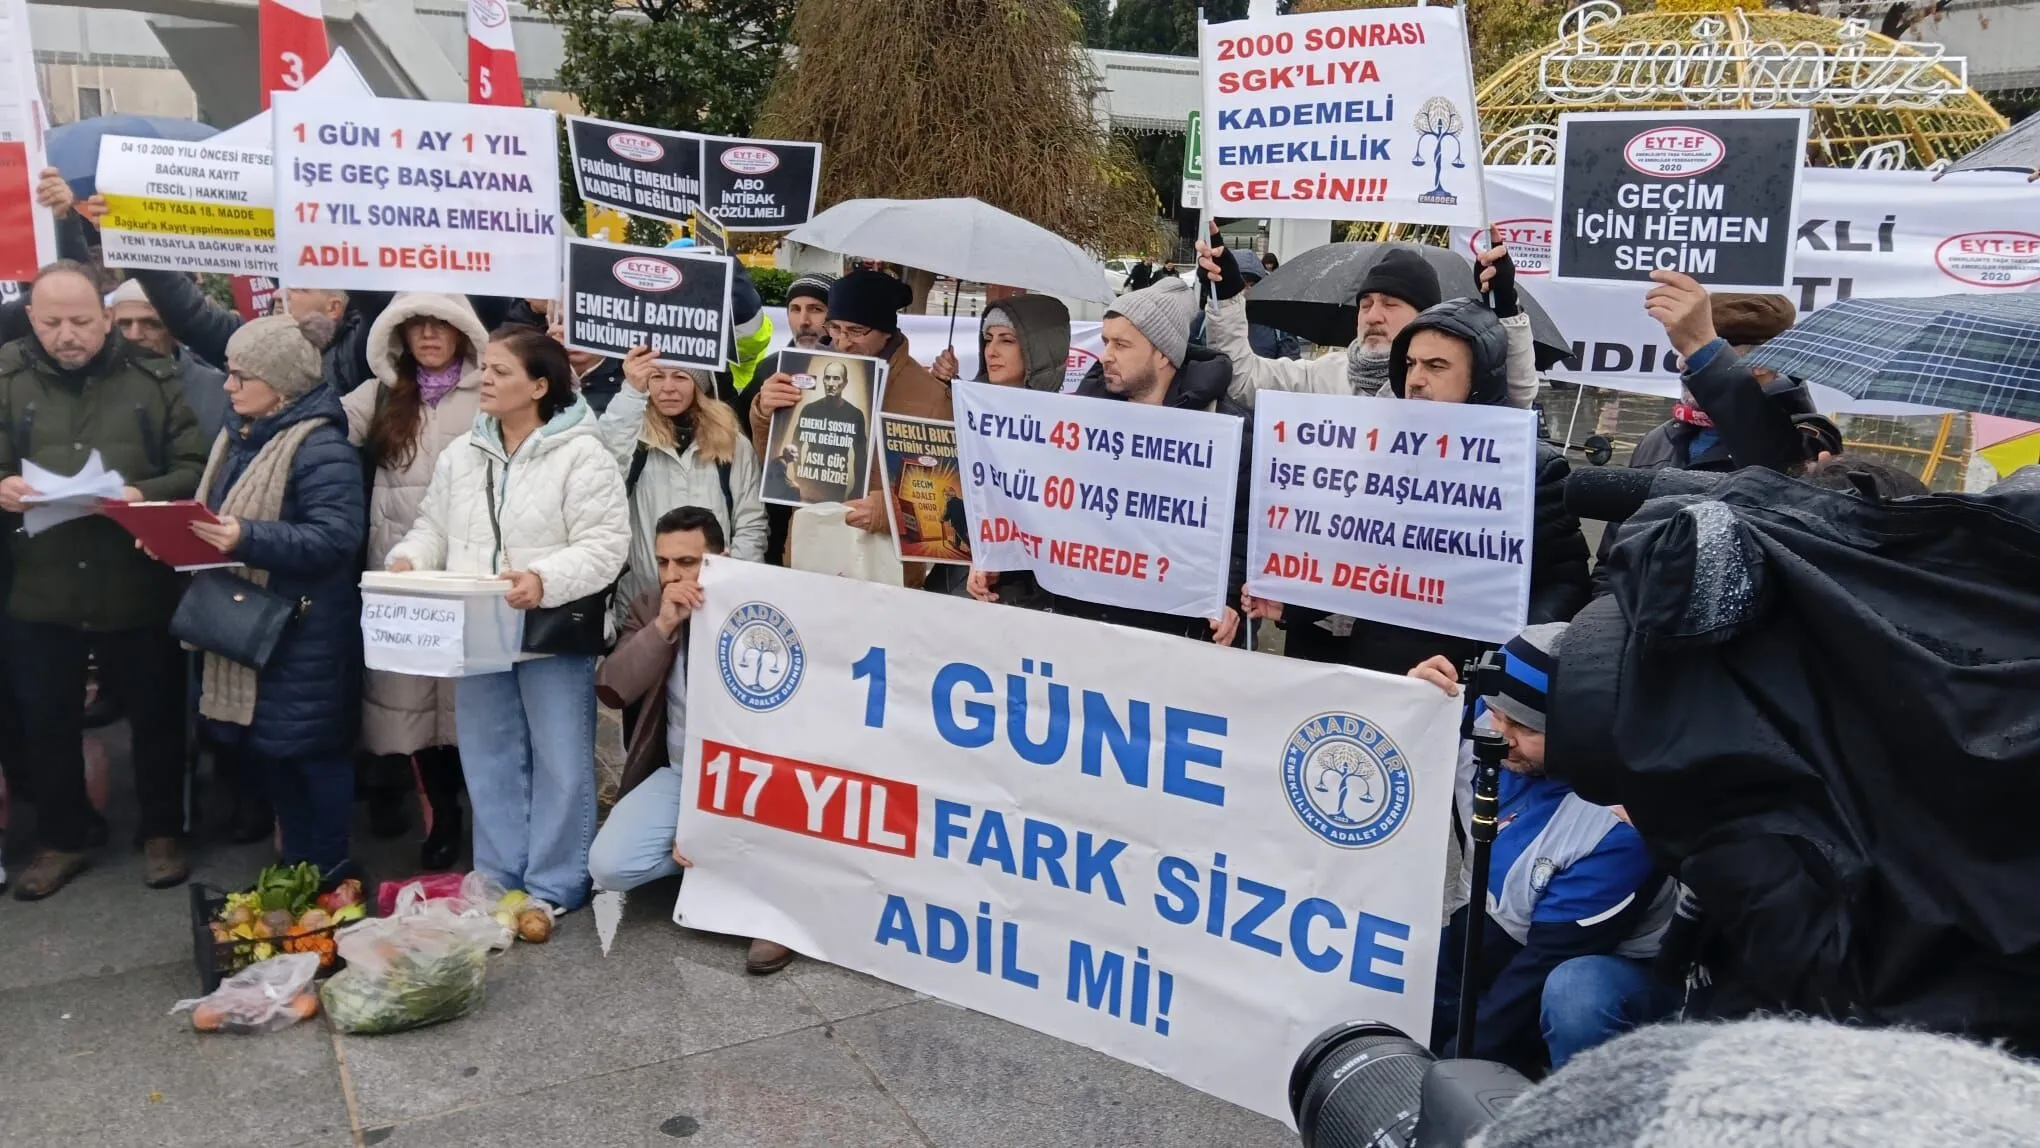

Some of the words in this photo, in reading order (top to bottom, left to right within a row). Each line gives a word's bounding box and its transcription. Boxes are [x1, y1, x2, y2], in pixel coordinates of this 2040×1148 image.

[1217, 32, 1294, 61] 2000
[1304, 22, 1426, 52] SONRASI
[280, 51, 304, 89] 3
[479, 67, 492, 99] 5
[1218, 60, 1381, 94] SGK'LIYA
[1218, 94, 1394, 131] KADEMELİ
[121, 142, 133, 152] 04
[137, 143, 148, 154] 10
[151, 144, 175, 156] 2000
[200, 148, 238, 163] ÖNCESİ
[293, 122, 305, 143] 1
[318, 121, 380, 148] GÜN
[391, 129, 403, 149] 1
[416, 131, 452, 151] AY
[462, 133, 474, 153] 1
[484, 134, 527, 156] YIL
[1219, 134, 1392, 166] EMEKLİLİK
[1645, 136, 1705, 148] EYT-EF
[155, 162, 206, 178] BAĞKURA
[209, 169, 240, 181] KAYIT
[293, 157, 333, 188] İŞE
[341, 164, 390, 189] GEÇ
[399, 167, 533, 193] BAŞLAYANA
[580, 157, 632, 182] FAKİRLİK
[634, 168, 699, 195] EMEKLİNİN
[733, 179, 765, 190] ABO
[1220, 172, 1388, 202] GELSİN!!!
[196, 188, 248, 202] HAKKIMIZ
[584, 176, 632, 202] KADERİ
[721, 190, 775, 205] İNTİBAK
[1617, 179, 1724, 215] GEÇİM
[142, 201, 167, 213] 1479
[170, 203, 196, 217] YASA
[218, 208, 254, 221] MADDE
[294, 203, 319, 224] 17
[326, 203, 361, 225] YIL
[368, 205, 441, 229] SONRA
[447, 207, 555, 236] EMEKLİLİK
[1576, 208, 1635, 244] İÇİN
[1644, 215, 1768, 243] HEMEN
[150, 236, 195, 250] YASAYLA
[298, 241, 369, 268] ADİL
[378, 244, 491, 273] DEĞİL!!!
[1960, 239, 2040, 254] EYT-EF
[628, 262, 669, 274] EYT-EF
[1980, 272, 2011, 280] 2020
[575, 291, 640, 323] EMEKLİ
[644, 302, 719, 333] BATIYOR
[575, 319, 648, 349] HÜKÜMET
[651, 333, 717, 359] BAKIYOR
[799, 431, 817, 443] ATIK
[818, 432, 854, 448] DEĞİLDİR
[800, 417, 827, 430] EMEKLİ
[827, 420, 857, 435] SOSYAL
[886, 421, 927, 441] EMEKLİ
[980, 412, 1046, 444] EYLÜL
[1050, 420, 1080, 450] 43
[1085, 427, 1125, 461] YAŞ
[1131, 434, 1214, 469] EMEKLİ
[1273, 421, 1285, 442] 1
[1297, 420, 1356, 449] GÜN
[1366, 428, 1379, 451] 1
[1390, 431, 1428, 456] AY
[1436, 434, 1449, 459] 1
[1459, 437, 1501, 463] YIL
[806, 451, 825, 466] ASIL
[827, 453, 846, 471] GÜÇ
[887, 439, 923, 454] GETİRİN
[797, 465, 819, 480] HALA
[1270, 457, 1306, 490] İŞE
[1312, 467, 1358, 497] GEÇ
[1364, 472, 1502, 510] BAŞLAYANA
[972, 462, 985, 486] 9
[1044, 475, 1075, 510] 60
[1080, 483, 1119, 521] YAŞ
[1125, 491, 1208, 529] EMEKLİ
[1267, 505, 1289, 529] 17
[1294, 508, 1321, 535] YIL
[1327, 513, 1395, 547] SONRA
[1402, 524, 1525, 564] EMEKLİLİK
[1050, 539, 1149, 580] NEREDE
[1157, 556, 1170, 583] ?
[1263, 552, 1323, 584] ADİL
[1331, 562, 1445, 605] DEĞİL!!!
[409, 608, 456, 623] YOKSA
[372, 629, 413, 645] SANDIK
[417, 634, 441, 647] VAR
[749, 695, 781, 706] ADALET
[851, 645, 888, 730] 1
[931, 657, 1229, 808] GÜNE
[1292, 716, 1403, 774] EMADDER
[1287, 756, 1328, 833] EMEKLİLİKTE
[1330, 828, 1378, 841] ADALET
[1379, 780, 1405, 831] DERNEĞİ
[704, 749, 774, 820] 17
[797, 769, 908, 851] YIL
[933, 799, 1130, 905] FARK
[1154, 852, 1413, 995] SİZCE
[875, 894, 1040, 990] ADİL
[1067, 941, 1174, 1038] Mİ!
[1333, 1053, 1368, 1079] Canon
